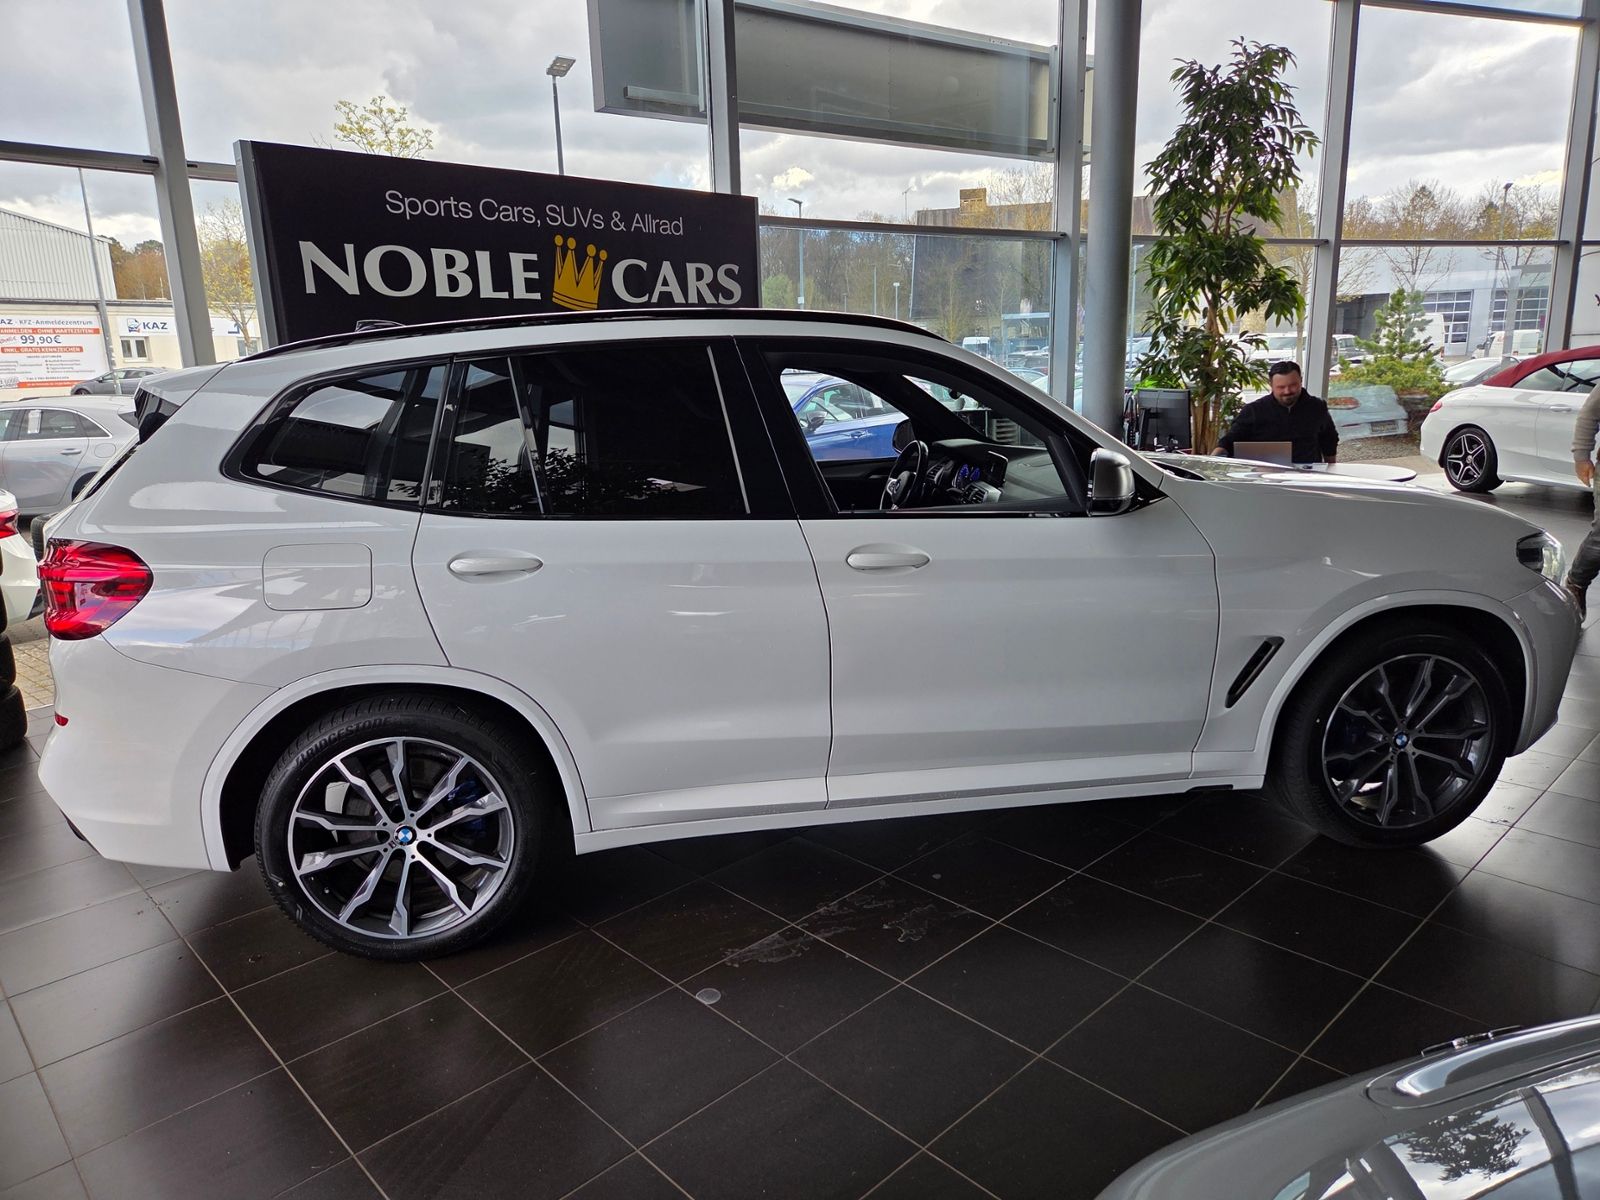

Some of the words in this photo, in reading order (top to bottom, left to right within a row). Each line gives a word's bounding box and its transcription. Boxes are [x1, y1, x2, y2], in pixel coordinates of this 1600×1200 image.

[385, 190, 473, 221] Sports
[478, 198, 541, 228] Cars,
[546, 203, 605, 230] SUVs
[610, 210, 626, 231] &
[631, 212, 684, 236] Allrad
[298, 240, 542, 300] NOBLE
[611, 258, 743, 305] CARS
[142, 322, 168, 330] KAZ
[295, 716, 393, 767] BRIDGESTONE
